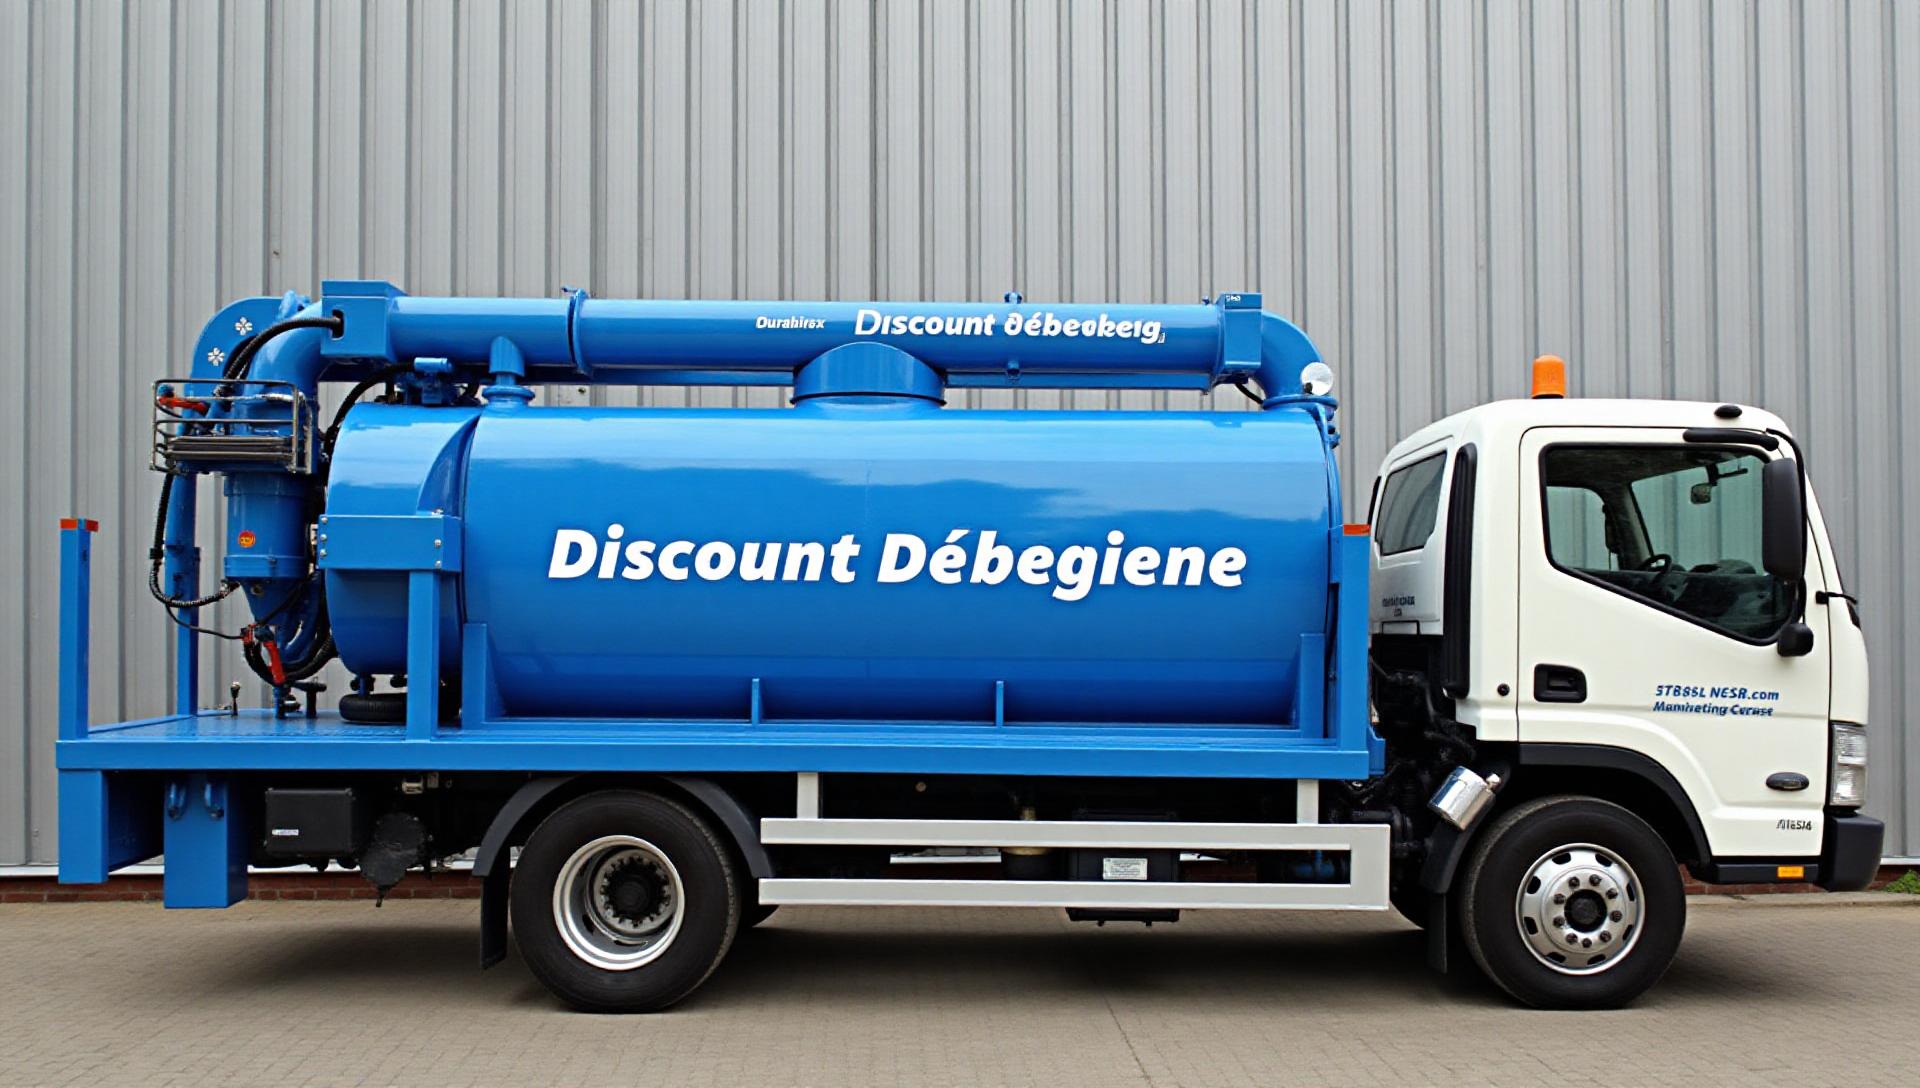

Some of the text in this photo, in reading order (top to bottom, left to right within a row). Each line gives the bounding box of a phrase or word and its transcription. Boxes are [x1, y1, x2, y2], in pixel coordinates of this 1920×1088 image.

[855, 309, 995, 336] Discount
[548, 524, 1247, 601] Discount Débegiene
